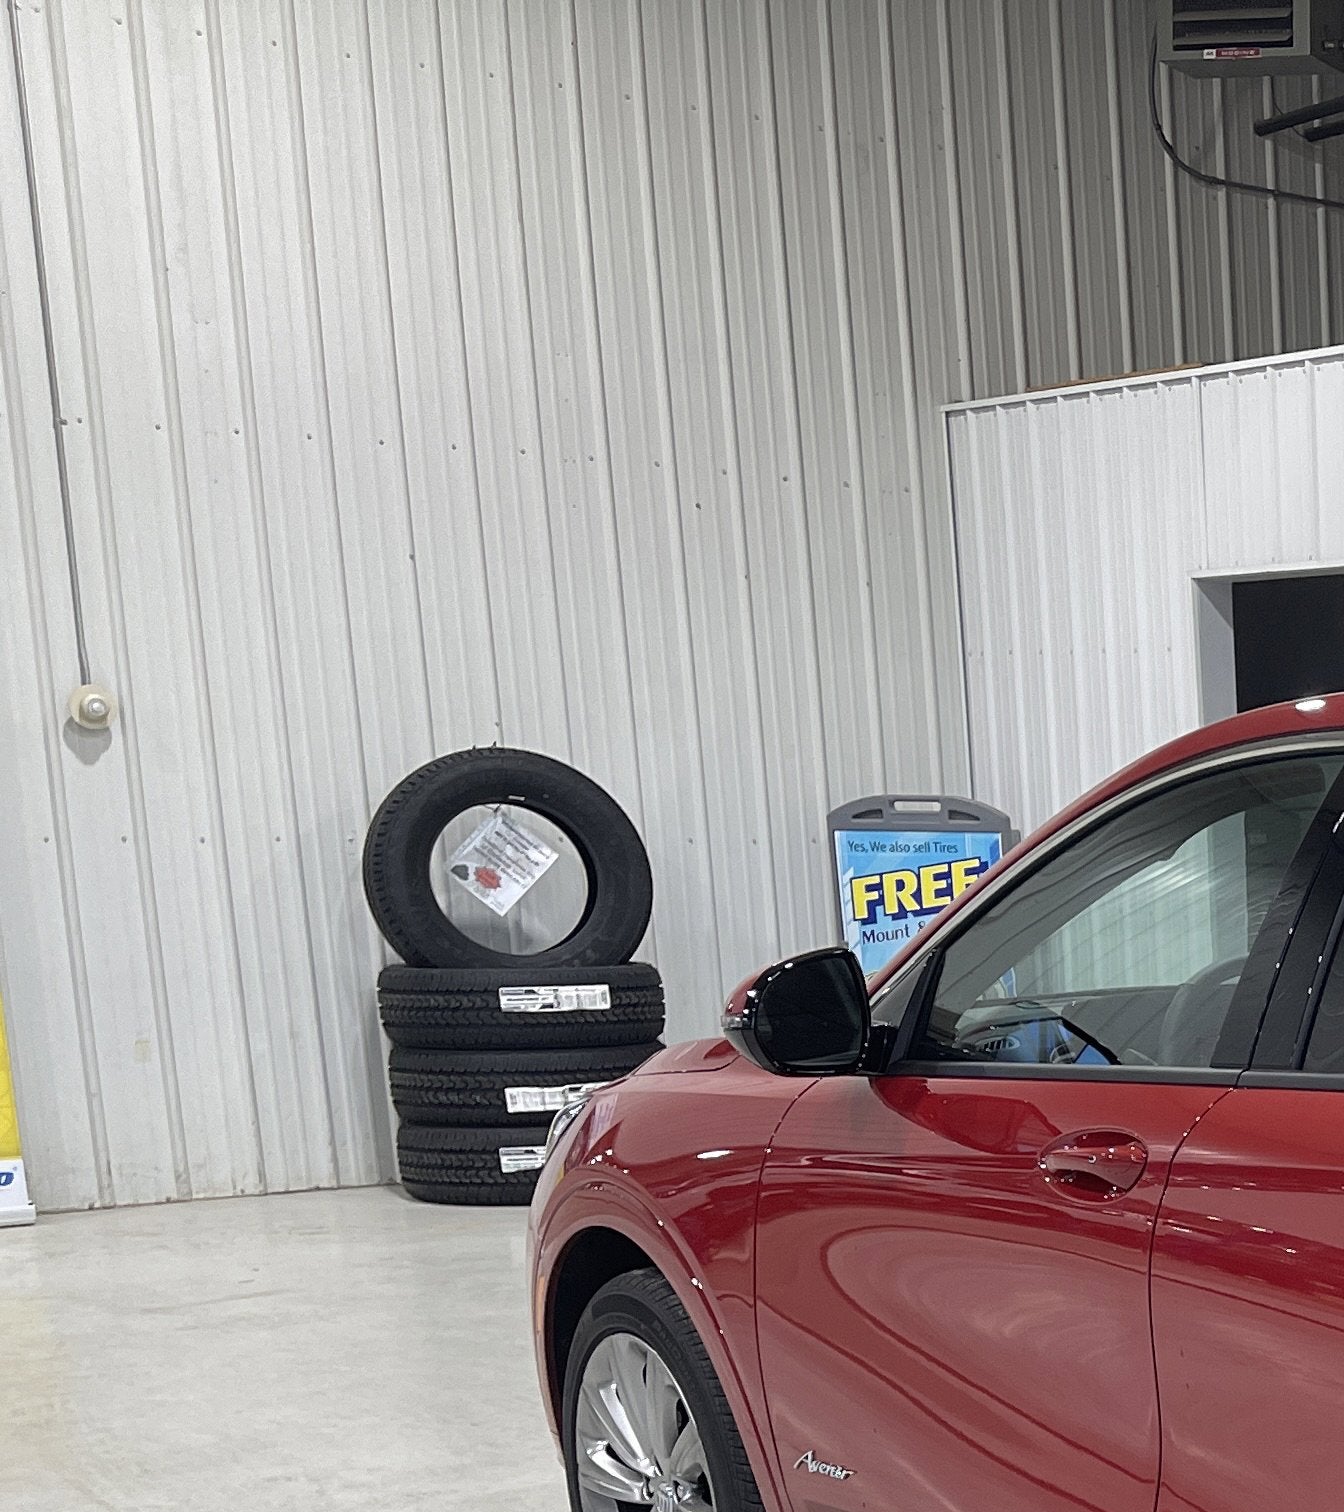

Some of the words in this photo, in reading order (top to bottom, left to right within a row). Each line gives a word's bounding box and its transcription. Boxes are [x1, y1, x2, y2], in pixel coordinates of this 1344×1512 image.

[848, 841, 868, 854] Yes,
[869, 842, 886, 852] We
[888, 841, 910, 852] also
[913, 841, 930, 852] sell
[932, 842, 958, 854] Tires
[851, 857, 981, 920] FREE
[862, 924, 910, 944] Mount
